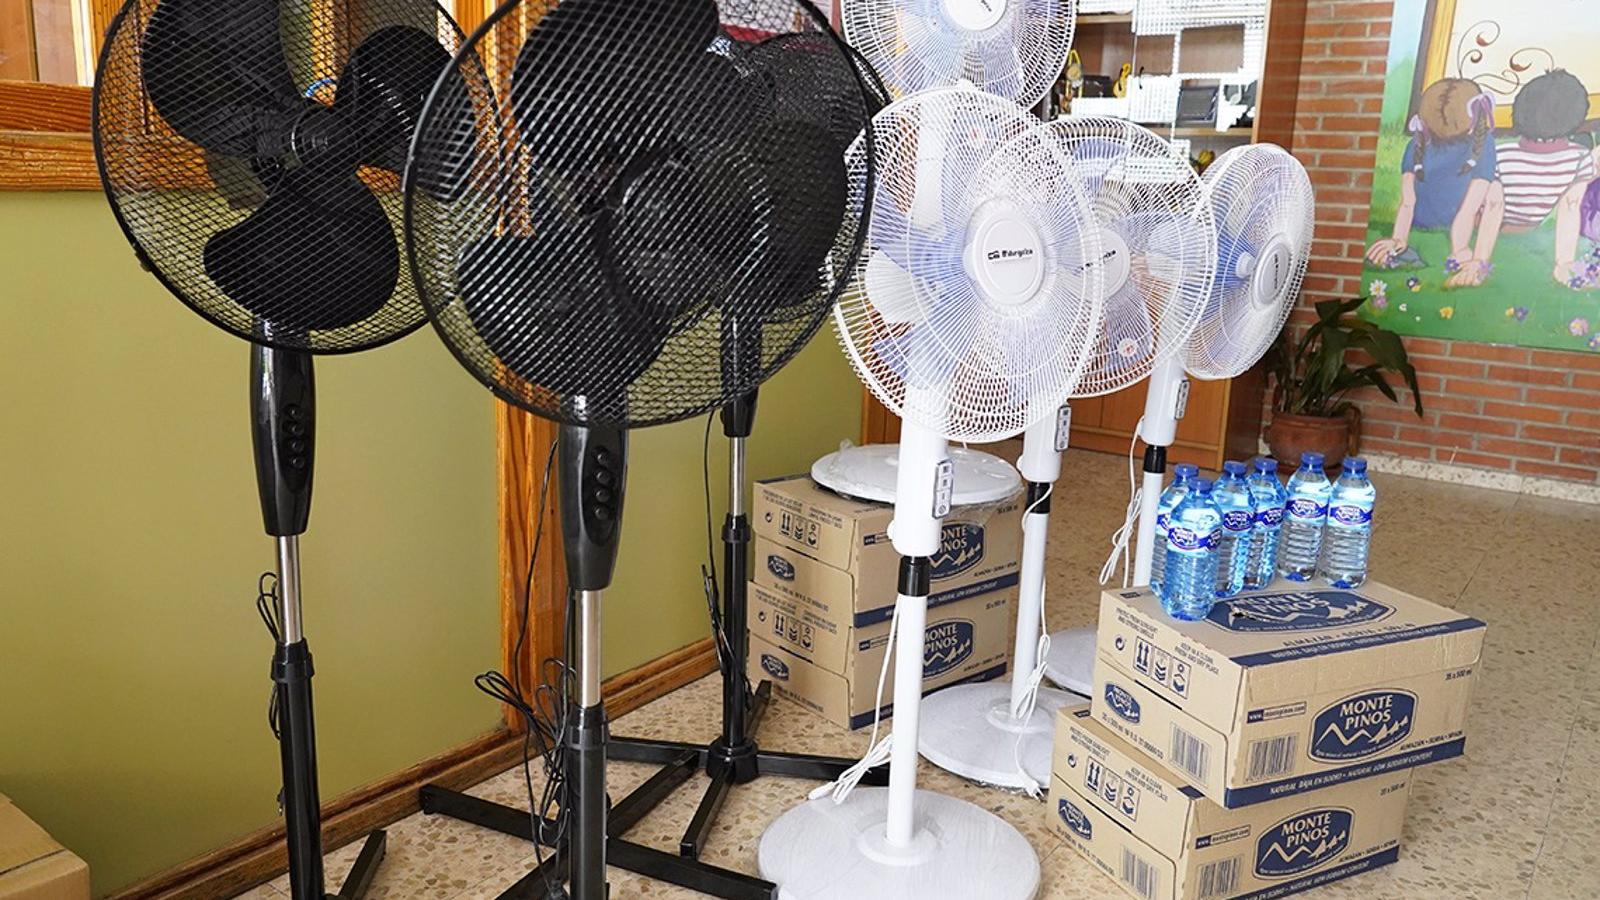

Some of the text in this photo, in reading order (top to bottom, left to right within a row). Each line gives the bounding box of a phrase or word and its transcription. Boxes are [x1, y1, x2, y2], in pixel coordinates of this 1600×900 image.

[939, 537, 968, 553] INOS
[940, 526, 968, 542] ONTE
[1340, 694, 1393, 717] MONTE
[1345, 708, 1391, 730] PINOS
[1281, 812, 1331, 836] MONTE
[1286, 826, 1330, 848] PINOS
